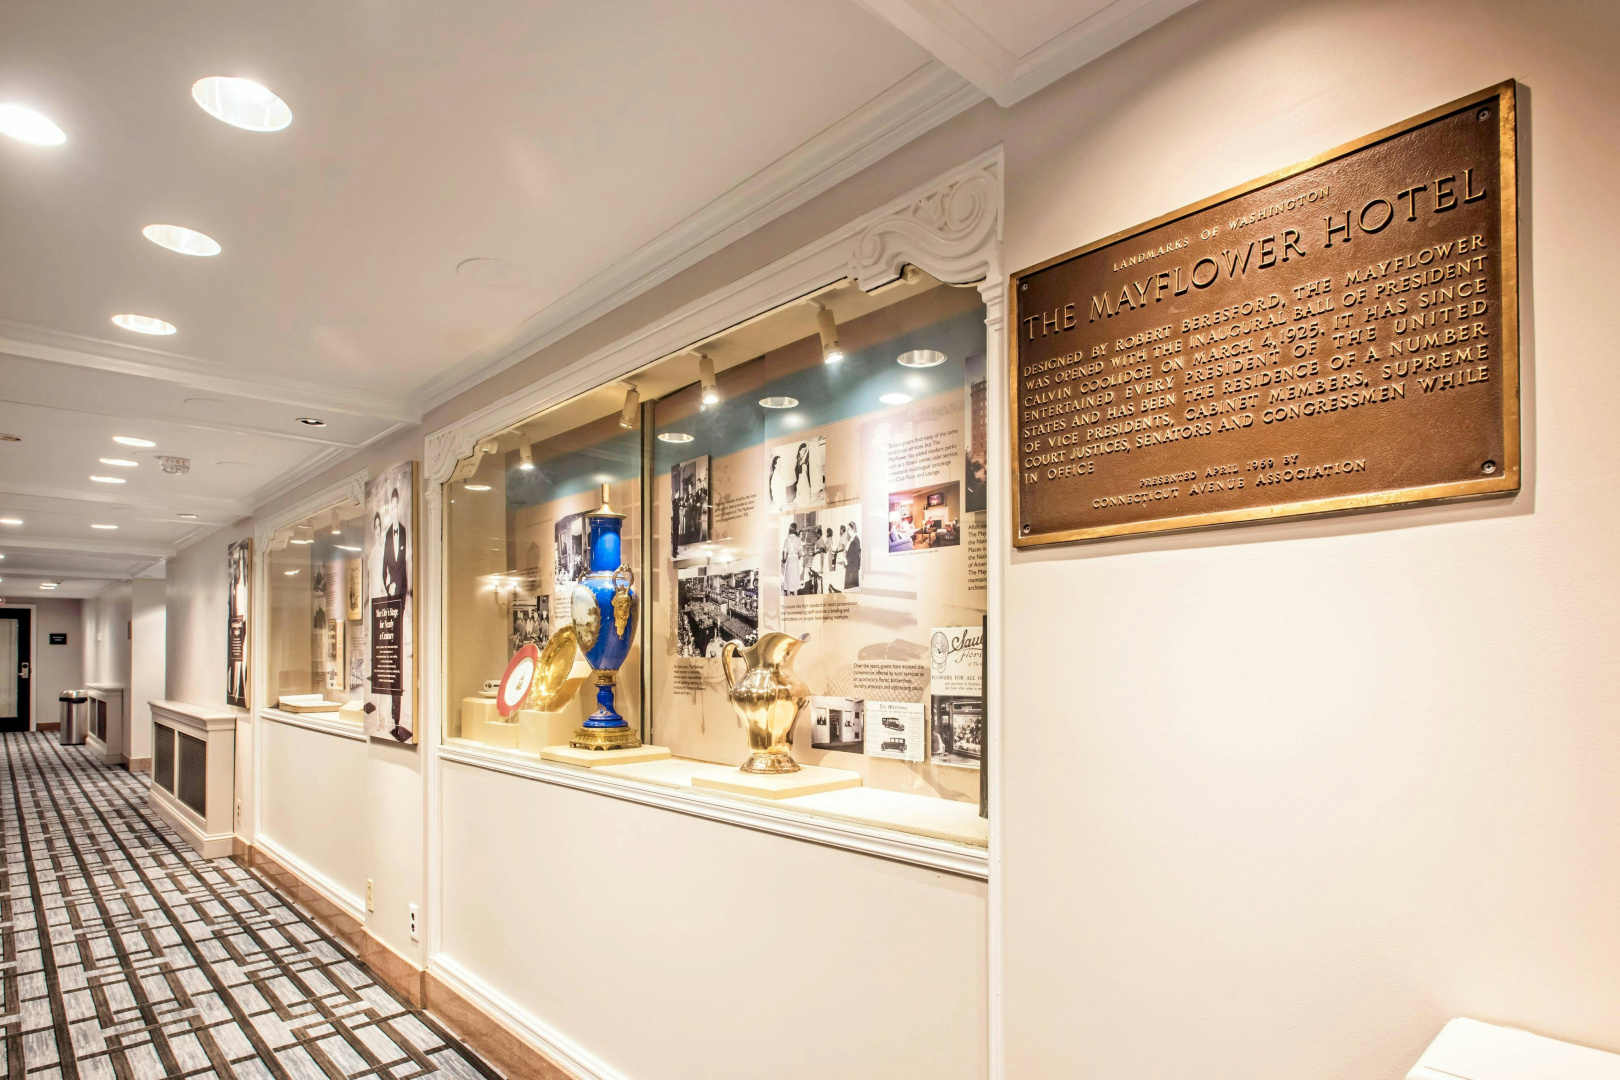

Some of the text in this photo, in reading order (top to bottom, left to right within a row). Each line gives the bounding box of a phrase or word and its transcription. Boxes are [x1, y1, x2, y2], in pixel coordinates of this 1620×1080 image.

[1024, 168, 1487, 341] THE MAYFLOWER HOTEL
[1113, 186, 1330, 272] LANDMARKS OF WASHINGTON
[1024, 234, 1487, 377] DESIGNED BY ROBERT BERESFORD, THE MAYFLOWER
[1024, 386, 1071, 408] CALVIN
[1080, 365, 1152, 394] COOLIDGE
[1162, 357, 1184, 372] ON
[1193, 338, 1254, 366] MARCH
[1334, 313, 1353, 330] IT
[1364, 298, 1408, 322] HAS
[1419, 278, 1487, 308] SINCE
[1026, 254, 1488, 391] WAS OPENED WITH THE INAUGURAL BALL OF PRESIDENT
[1024, 299, 1488, 423] ENTERTAINED EVERY PRESIDENT OF THE UNITED
[1024, 322, 1489, 438] STATES AND HAS BEEN THE RESIDENCE OF A NUMBER
[1024, 344, 1488, 454] OF VICE PRESIDENTS, CABINET MEMBERS, SUPREME
[166, 457, 186, 466] FIRE
[1024, 366, 1489, 468] COURT JUSTICES, SENATORS AND CONGRESSMEN WHILE
[1140, 470, 1196, 488] PRESENTED
[1205, 463, 1238, 478] APRIL
[1283, 454, 1300, 466] BY
[1024, 461, 1095, 485] IN OFFICE
[1092, 459, 1366, 509] CONNECTICUT AVENUE ASSOCIATION
